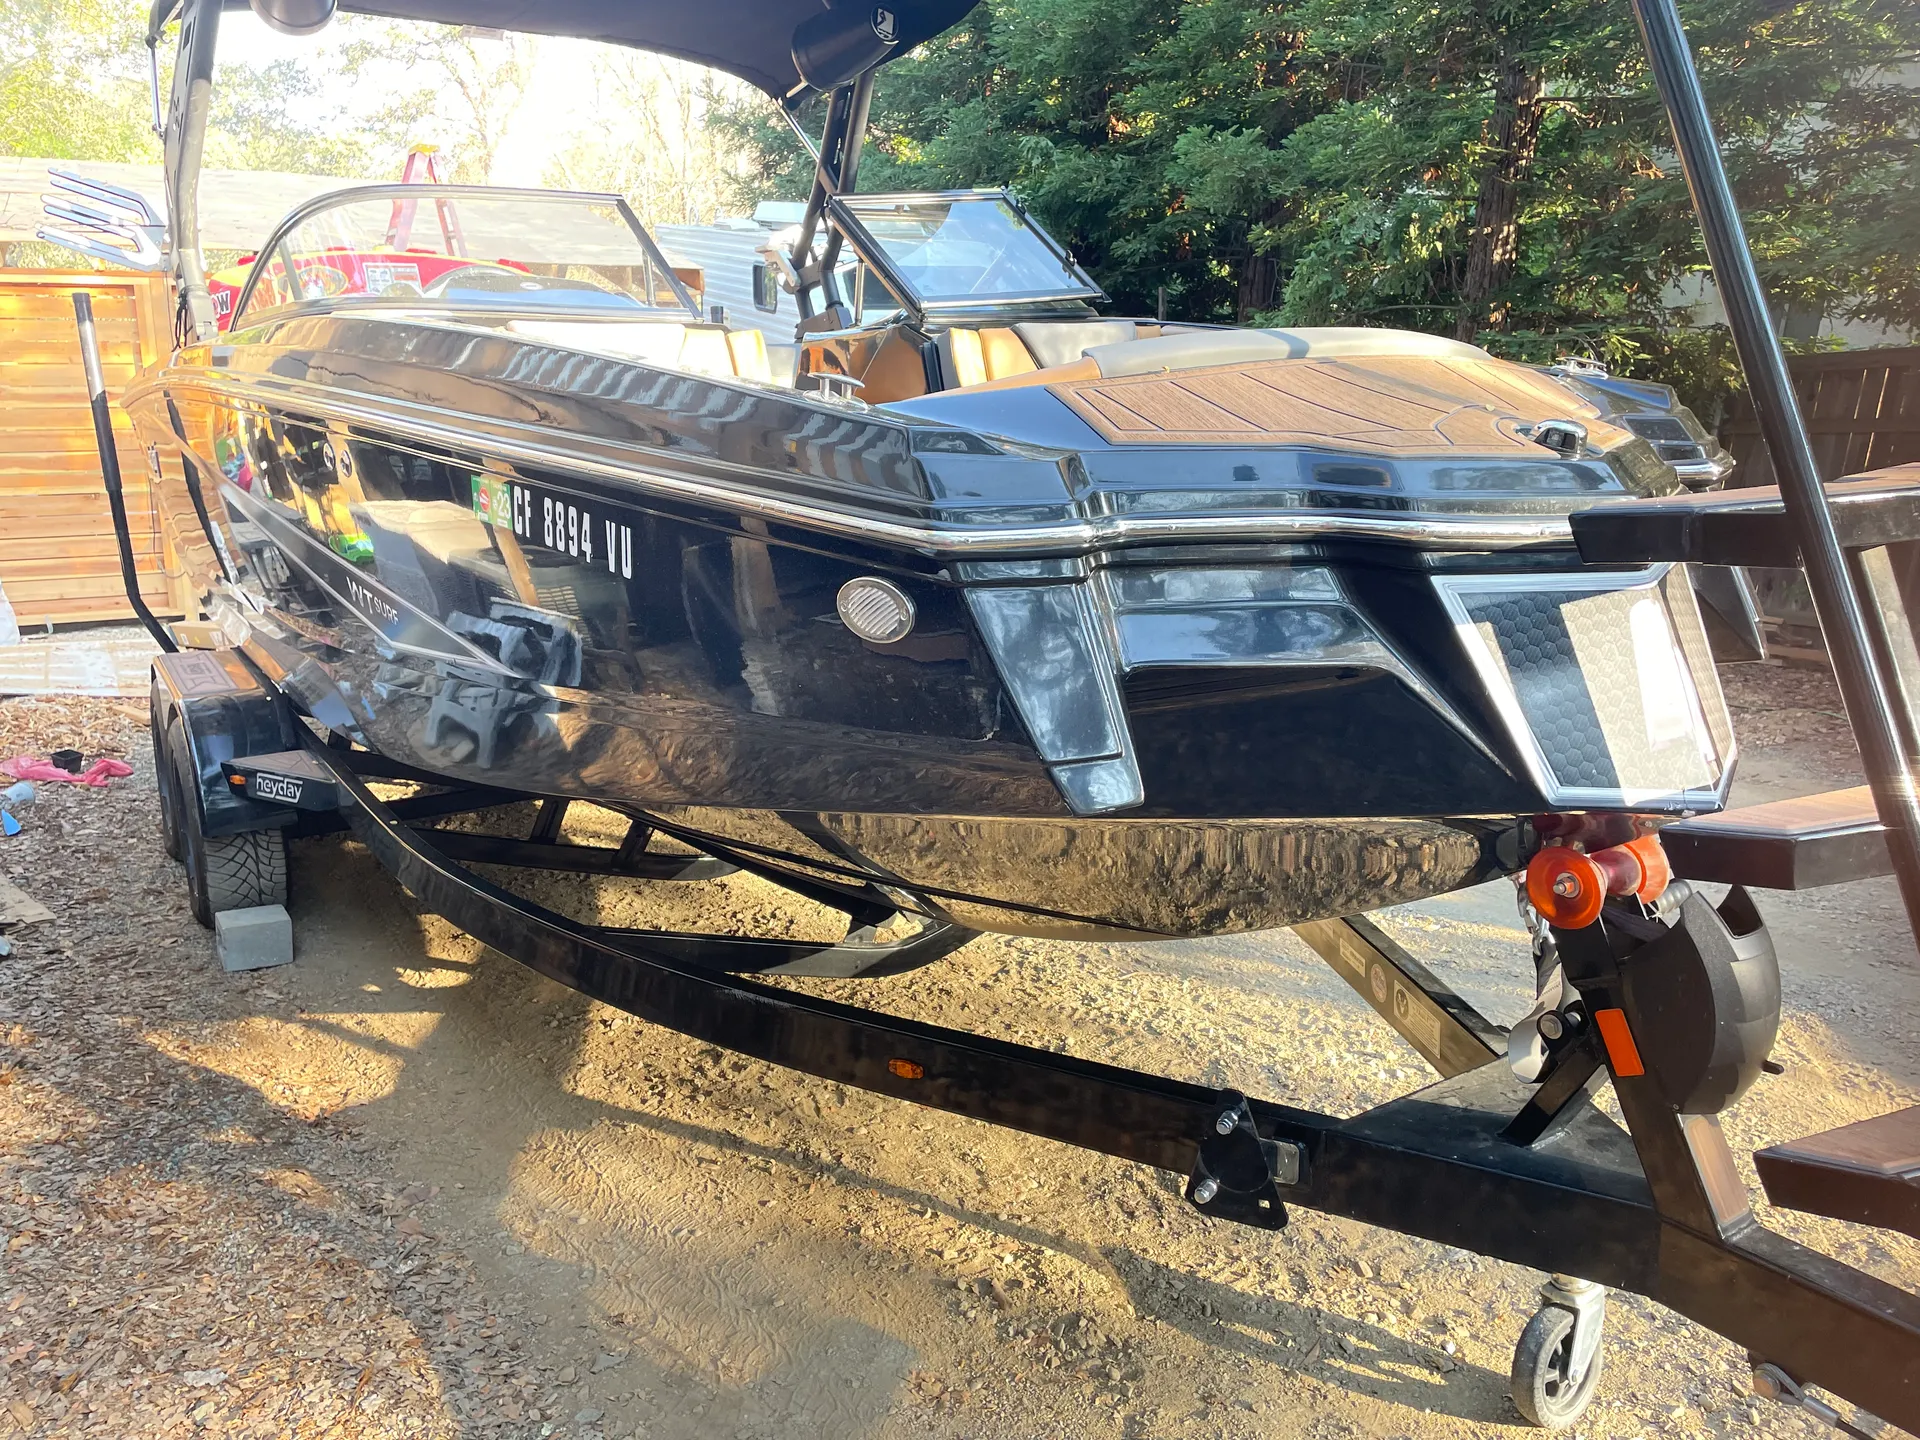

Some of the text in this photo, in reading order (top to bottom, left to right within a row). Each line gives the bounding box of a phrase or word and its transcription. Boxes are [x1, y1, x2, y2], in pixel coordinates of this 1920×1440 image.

[497, 491, 511, 519] 23
[513, 485, 532, 538] CF
[543, 496, 592, 564] 8894
[605, 519, 633, 580] VU
[346, 576, 399, 625] WT SURF
[256, 772, 303, 804] heyday
